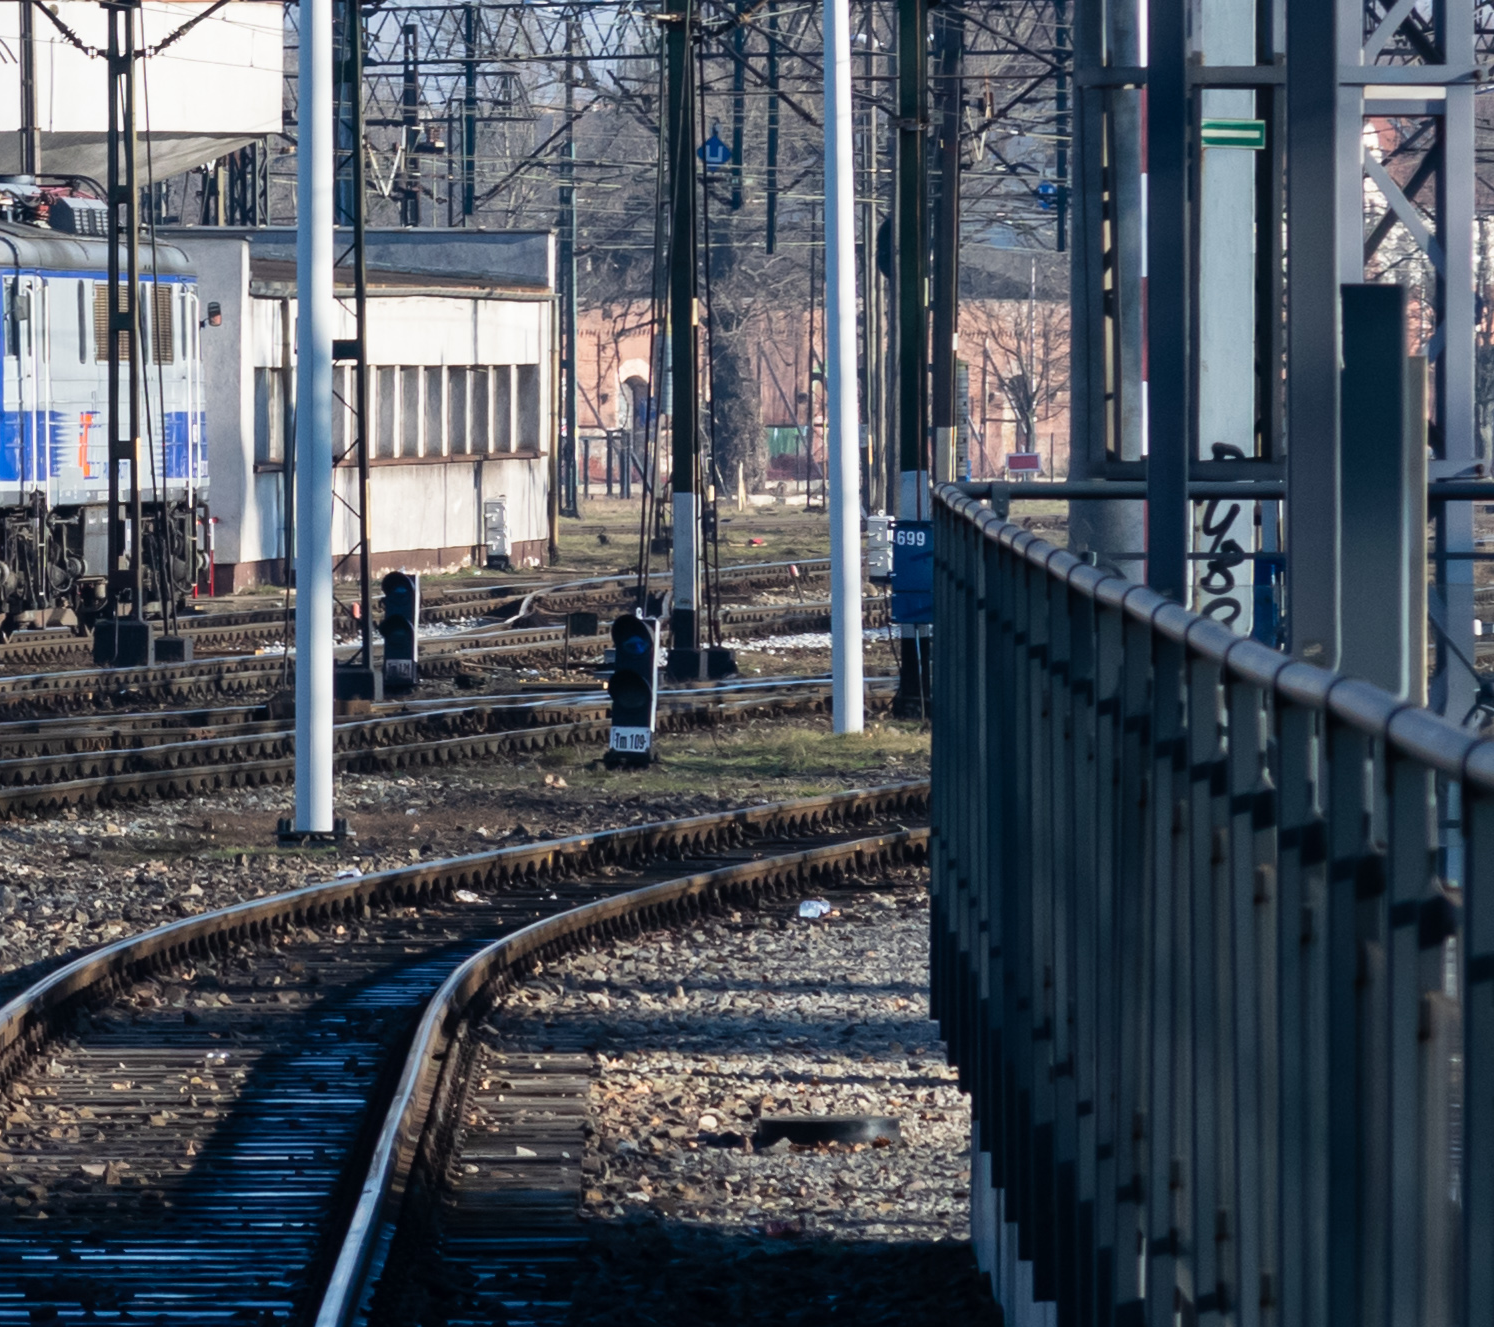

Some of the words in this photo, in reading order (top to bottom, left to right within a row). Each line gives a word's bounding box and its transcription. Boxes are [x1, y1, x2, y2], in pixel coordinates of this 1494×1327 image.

[897, 530, 926, 547] 699
[615, 732, 627, 749] Tm
[630, 734, 645, 750] 109
